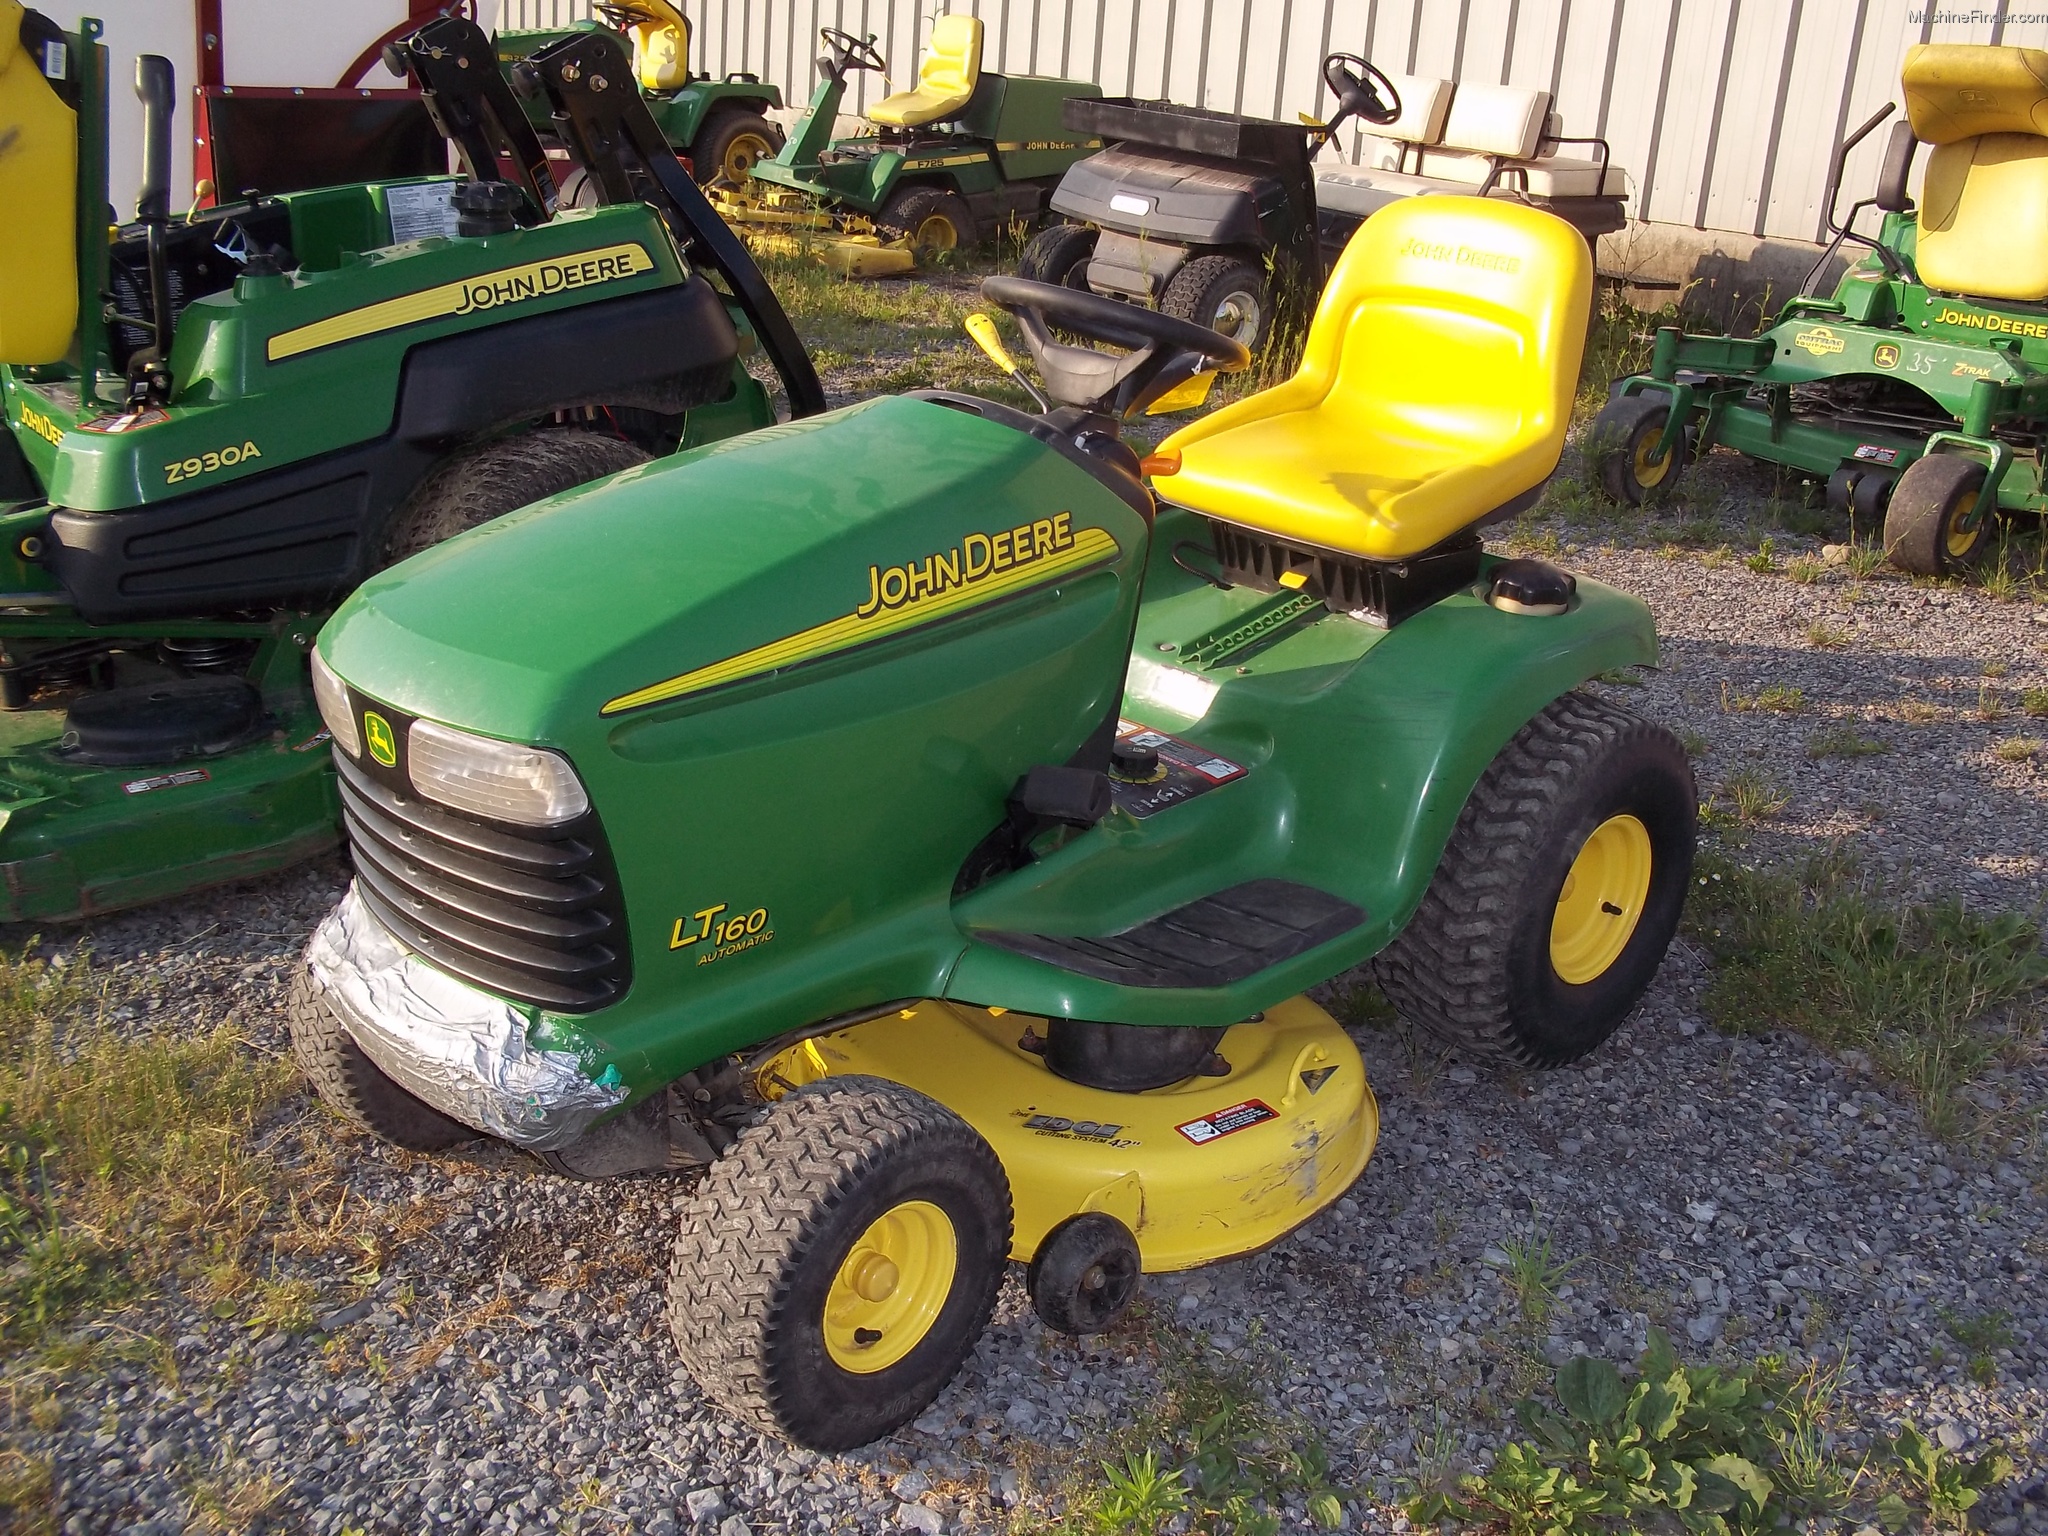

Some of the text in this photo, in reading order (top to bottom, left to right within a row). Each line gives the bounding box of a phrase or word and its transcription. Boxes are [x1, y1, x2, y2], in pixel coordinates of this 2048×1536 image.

[1026, 142, 1048, 150] JOHN
[918, 159, 944, 168] F725
[1400, 237, 1453, 262] JOHN
[455, 253, 634, 313] JOHN DEERE
[1935, 308, 2048, 339] JOHN DEERE
[20, 401, 45, 437] JOHN
[163, 440, 262, 485] Z930A
[857, 511, 1074, 618] JOHN DEERE
[697, 930, 775, 967] AUTOMATIC
[1022, 1114, 1123, 1139] EDGE
[1035, 1129, 1071, 1140] CUTTING
[1071, 1135, 1107, 1144] SYSTEM
